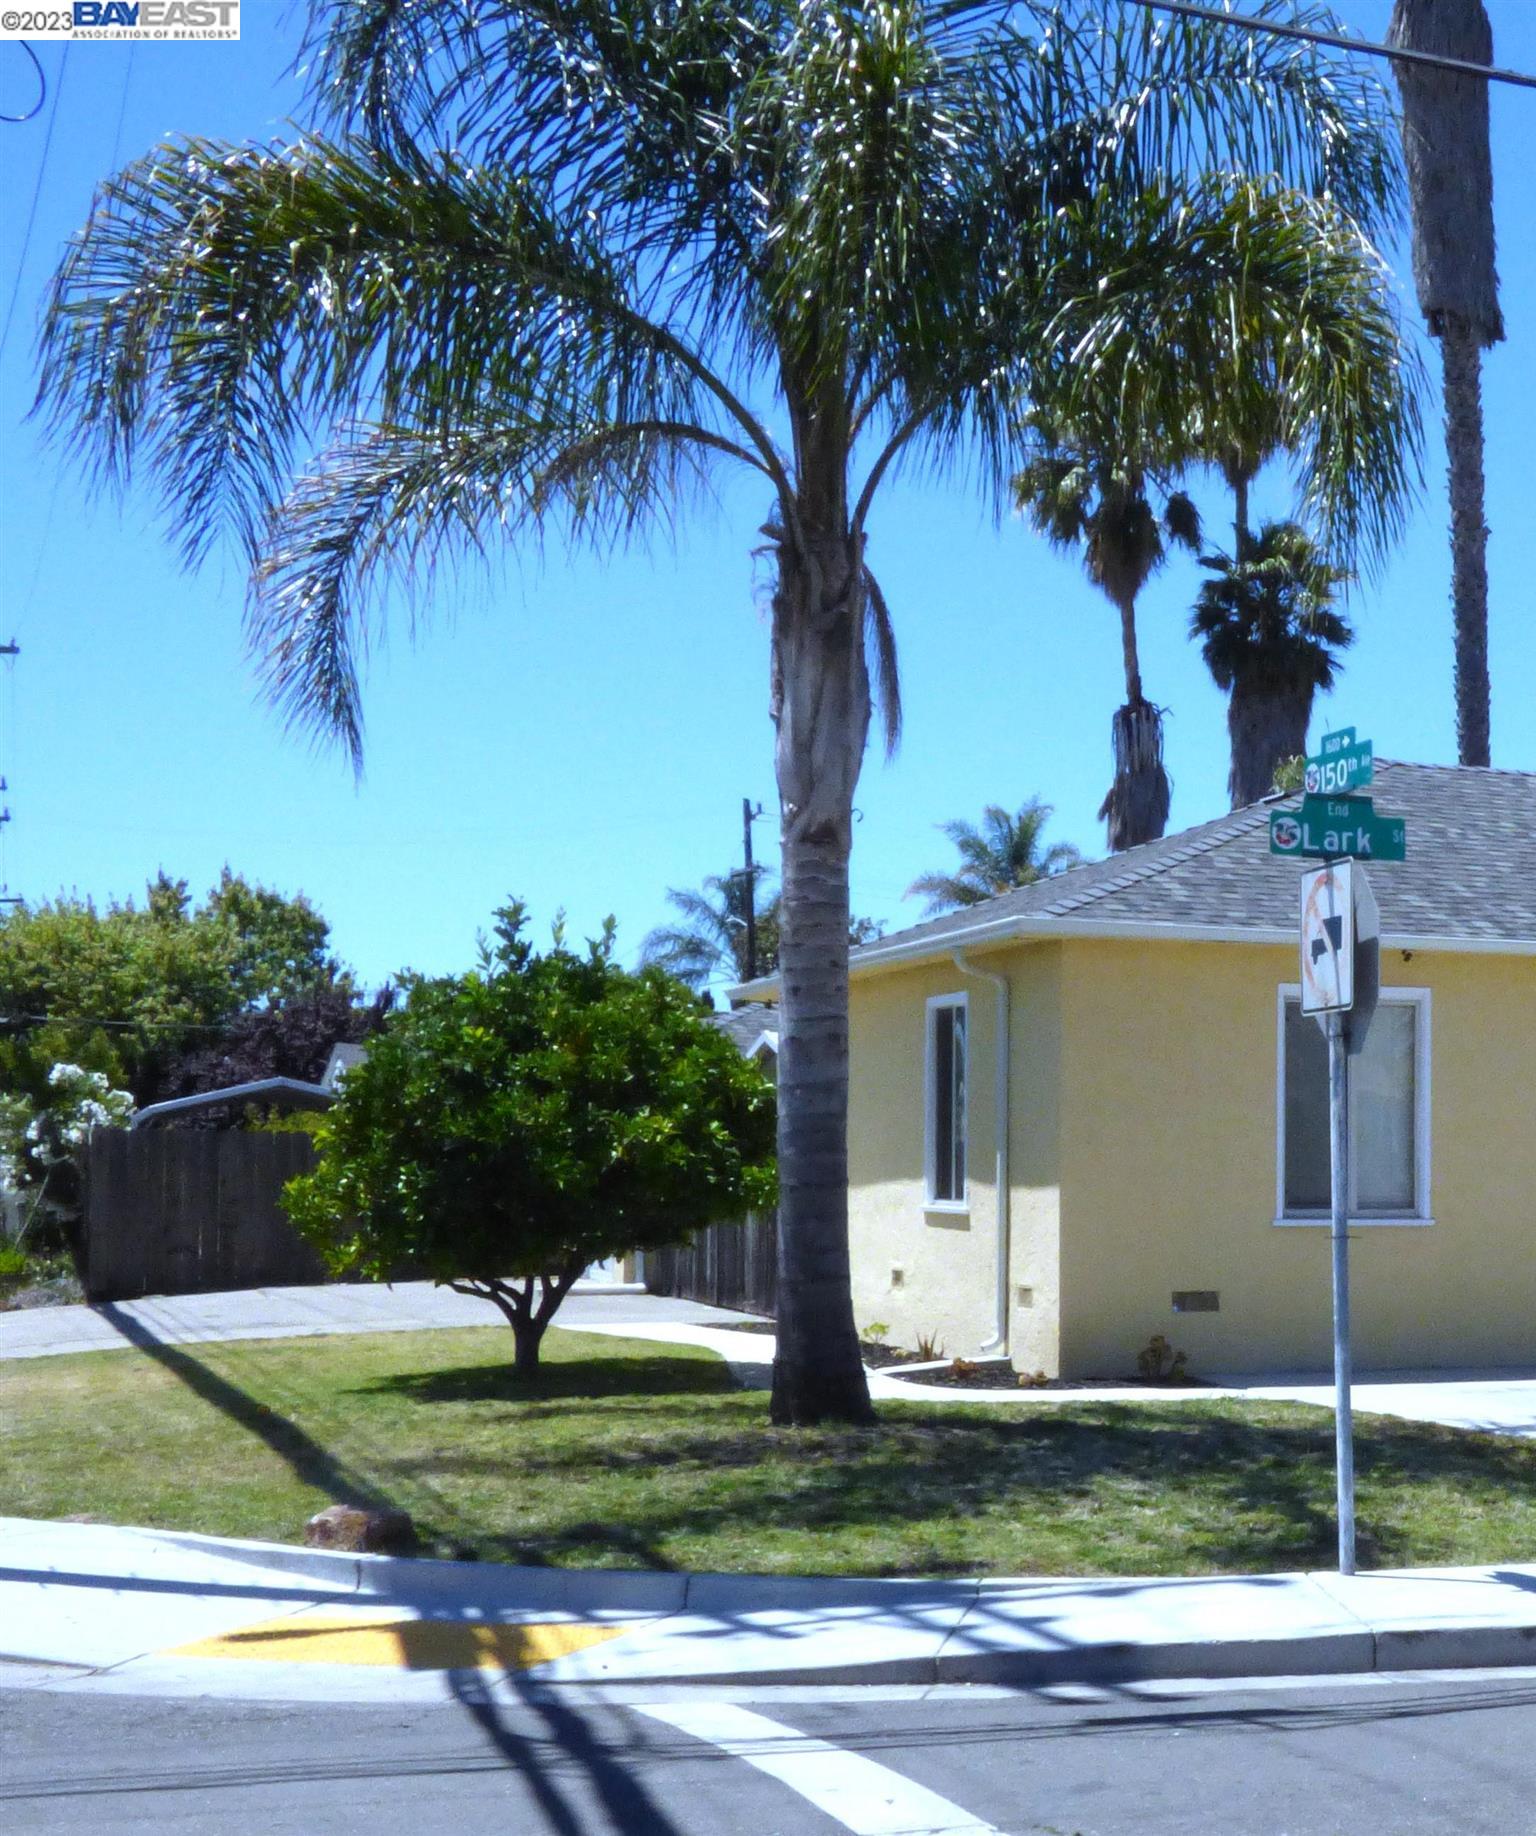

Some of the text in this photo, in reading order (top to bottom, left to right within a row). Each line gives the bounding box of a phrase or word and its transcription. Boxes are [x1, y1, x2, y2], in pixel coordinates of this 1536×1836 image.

[1320, 757, 1358, 793] 150th
[1327, 801, 1350, 818] End
[1302, 822, 1371, 854] Lark
